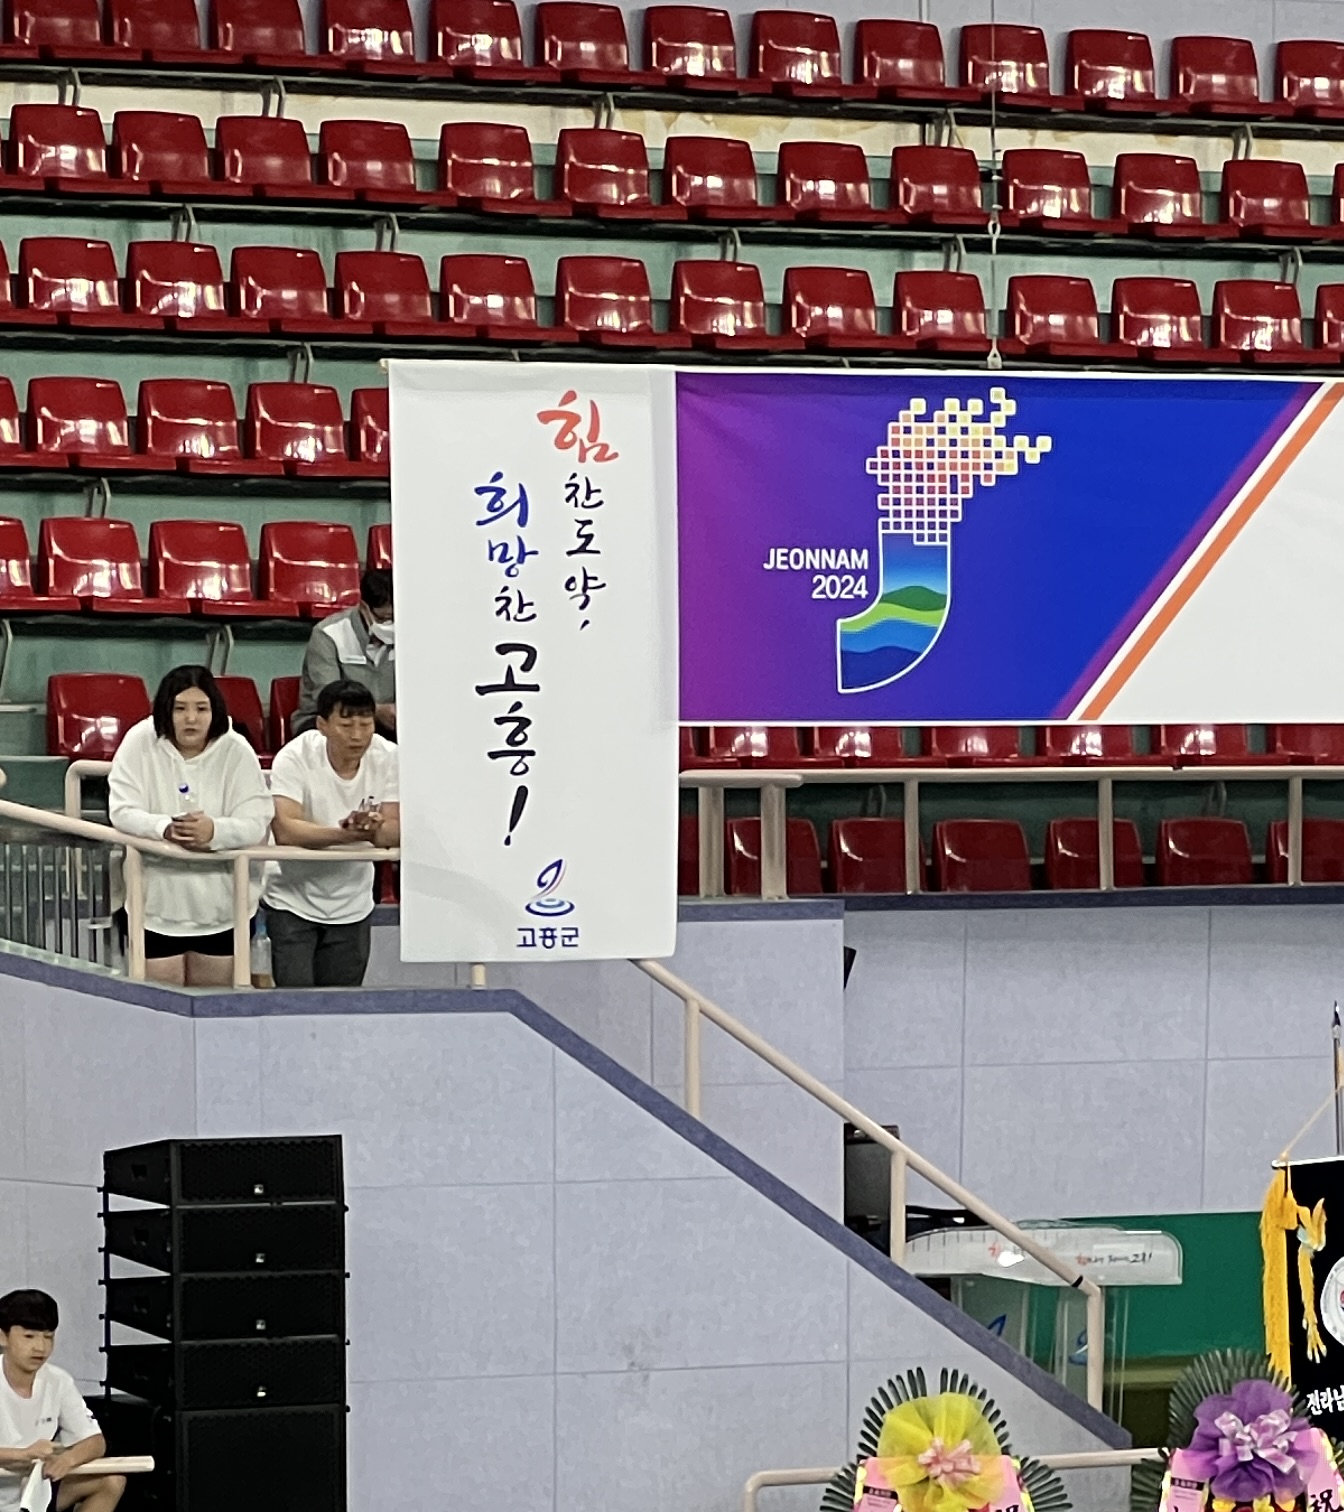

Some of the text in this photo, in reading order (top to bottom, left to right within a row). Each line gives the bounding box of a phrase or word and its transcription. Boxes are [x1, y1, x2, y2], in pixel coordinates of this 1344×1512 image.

[763, 548, 869, 571] JEONNAM
[811, 575, 869, 599] 2024
[516, 926, 579, 949] 고흥군
